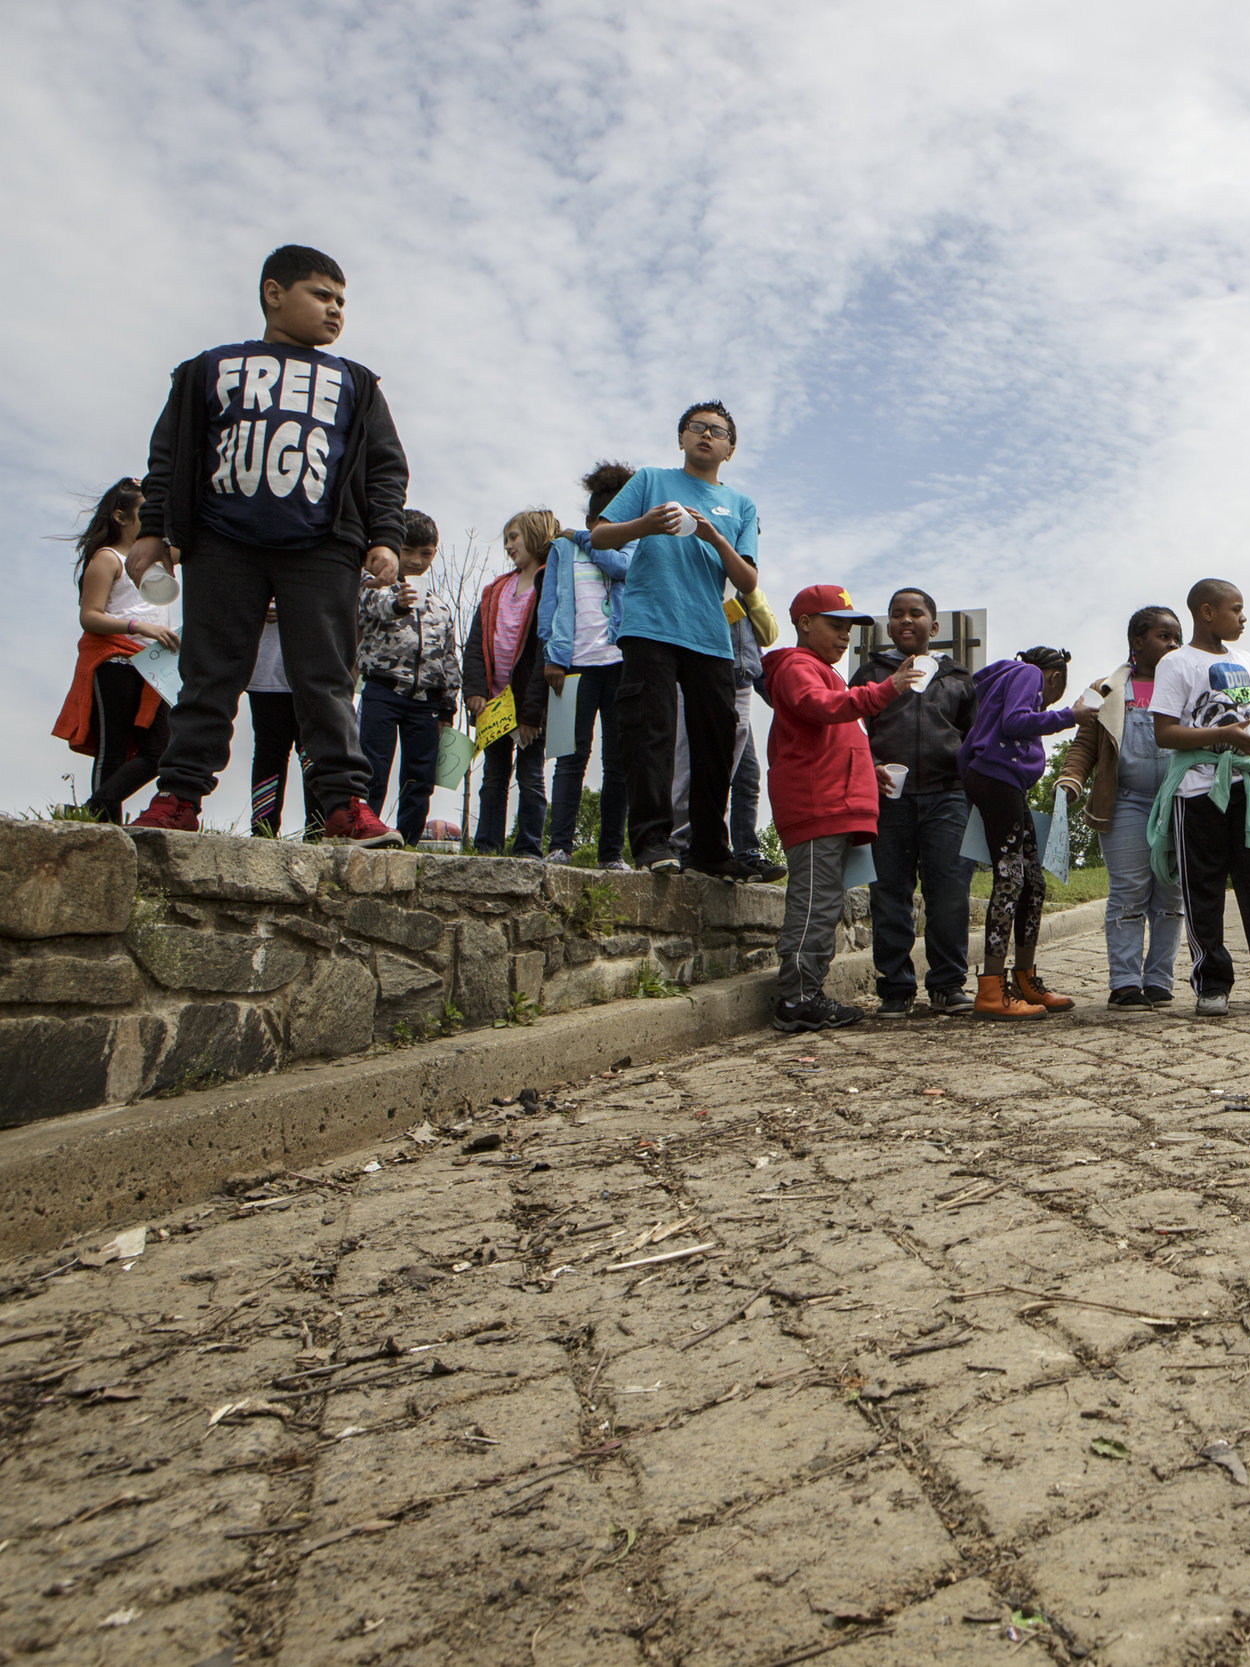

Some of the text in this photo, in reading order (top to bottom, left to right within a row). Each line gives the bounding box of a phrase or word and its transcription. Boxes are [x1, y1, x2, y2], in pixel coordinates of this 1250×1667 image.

[216, 355, 342, 426] FREE
[211, 419, 330, 504] HUGS
[1224, 671, 1250, 689] DUD
